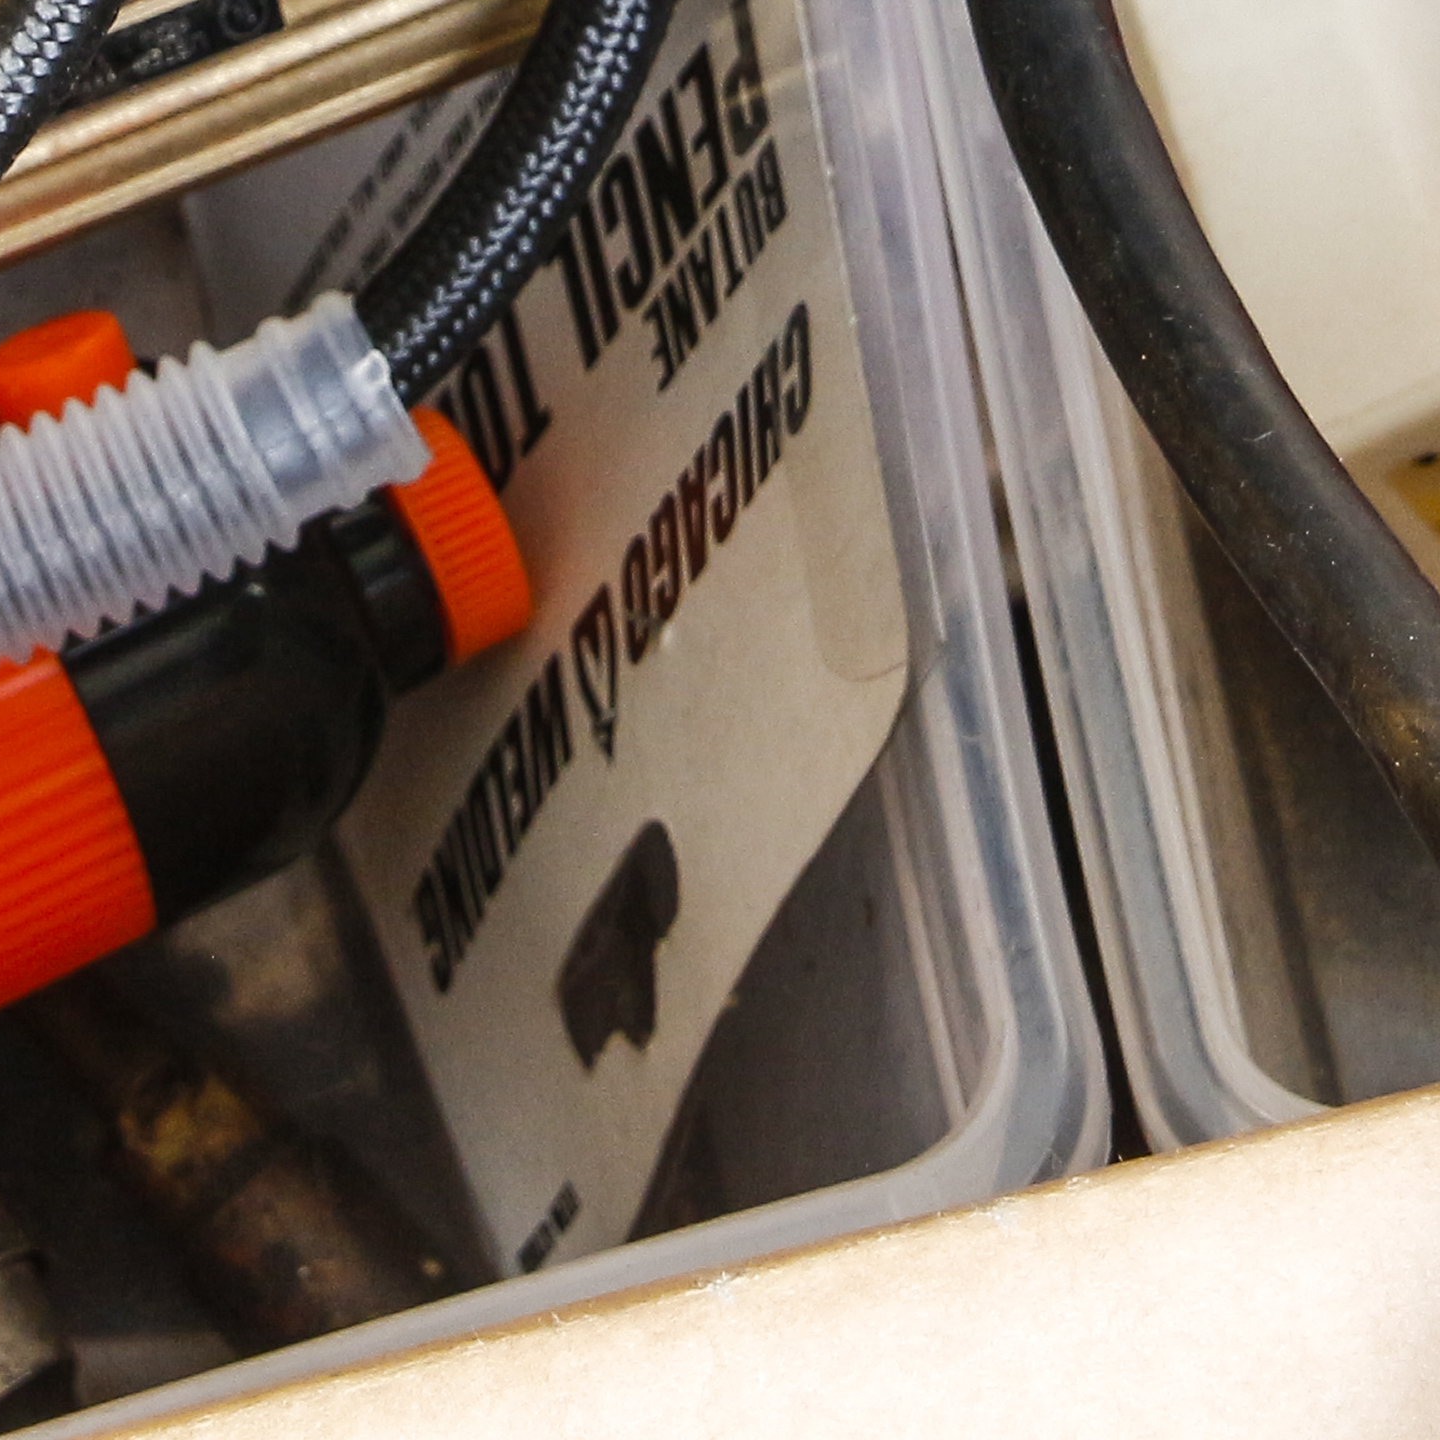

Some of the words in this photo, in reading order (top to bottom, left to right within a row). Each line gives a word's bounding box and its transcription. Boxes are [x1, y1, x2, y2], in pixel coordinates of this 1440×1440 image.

[642, 138, 788, 394] BUTANE
[621, 301, 812, 665] CHICAGO
[413, 651, 573, 996] WELDING
